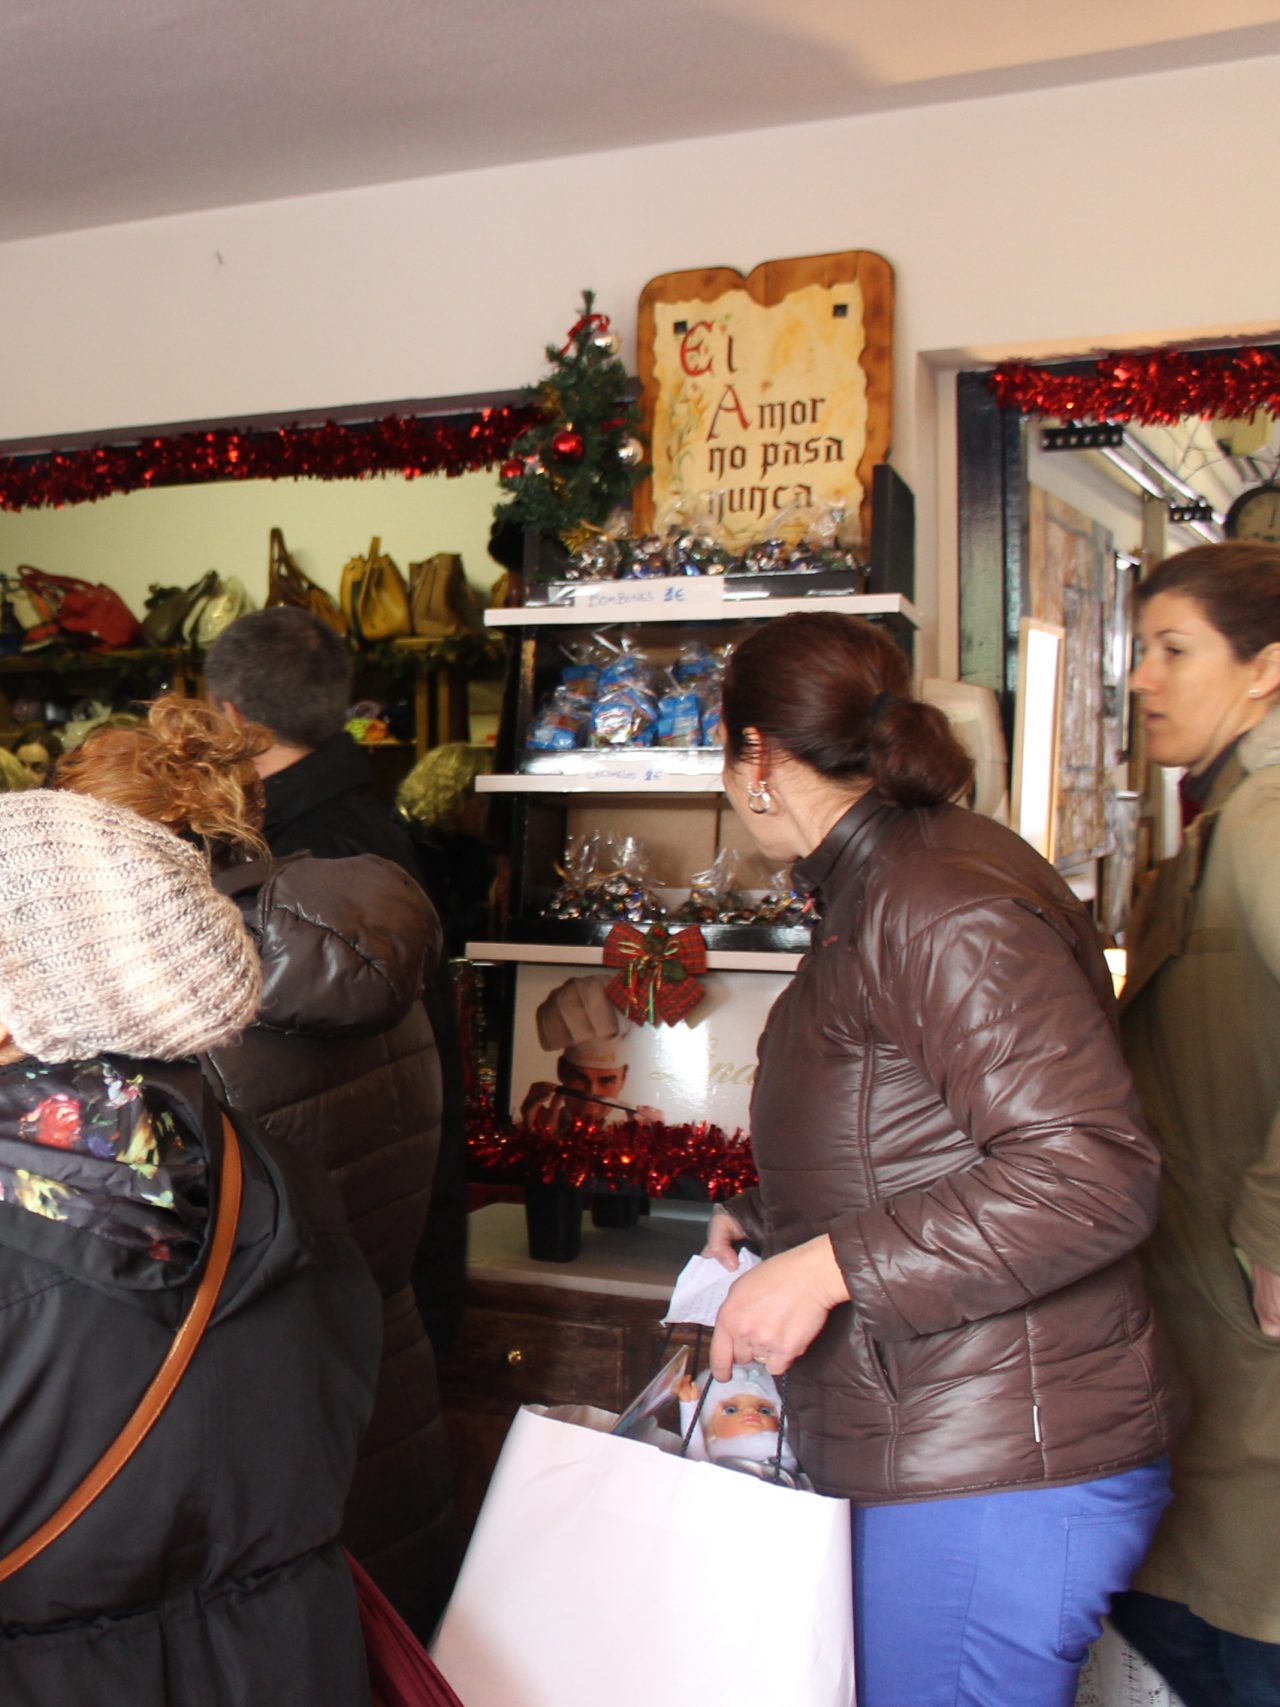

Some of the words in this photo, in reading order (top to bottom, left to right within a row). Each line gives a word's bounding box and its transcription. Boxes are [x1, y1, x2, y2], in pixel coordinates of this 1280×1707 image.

[680, 320, 737, 377] El
[706, 384, 826, 441] Amor
[708, 445, 747, 481] no
[760, 437, 845, 481] pasa
[708, 483, 814, 525] nunca
